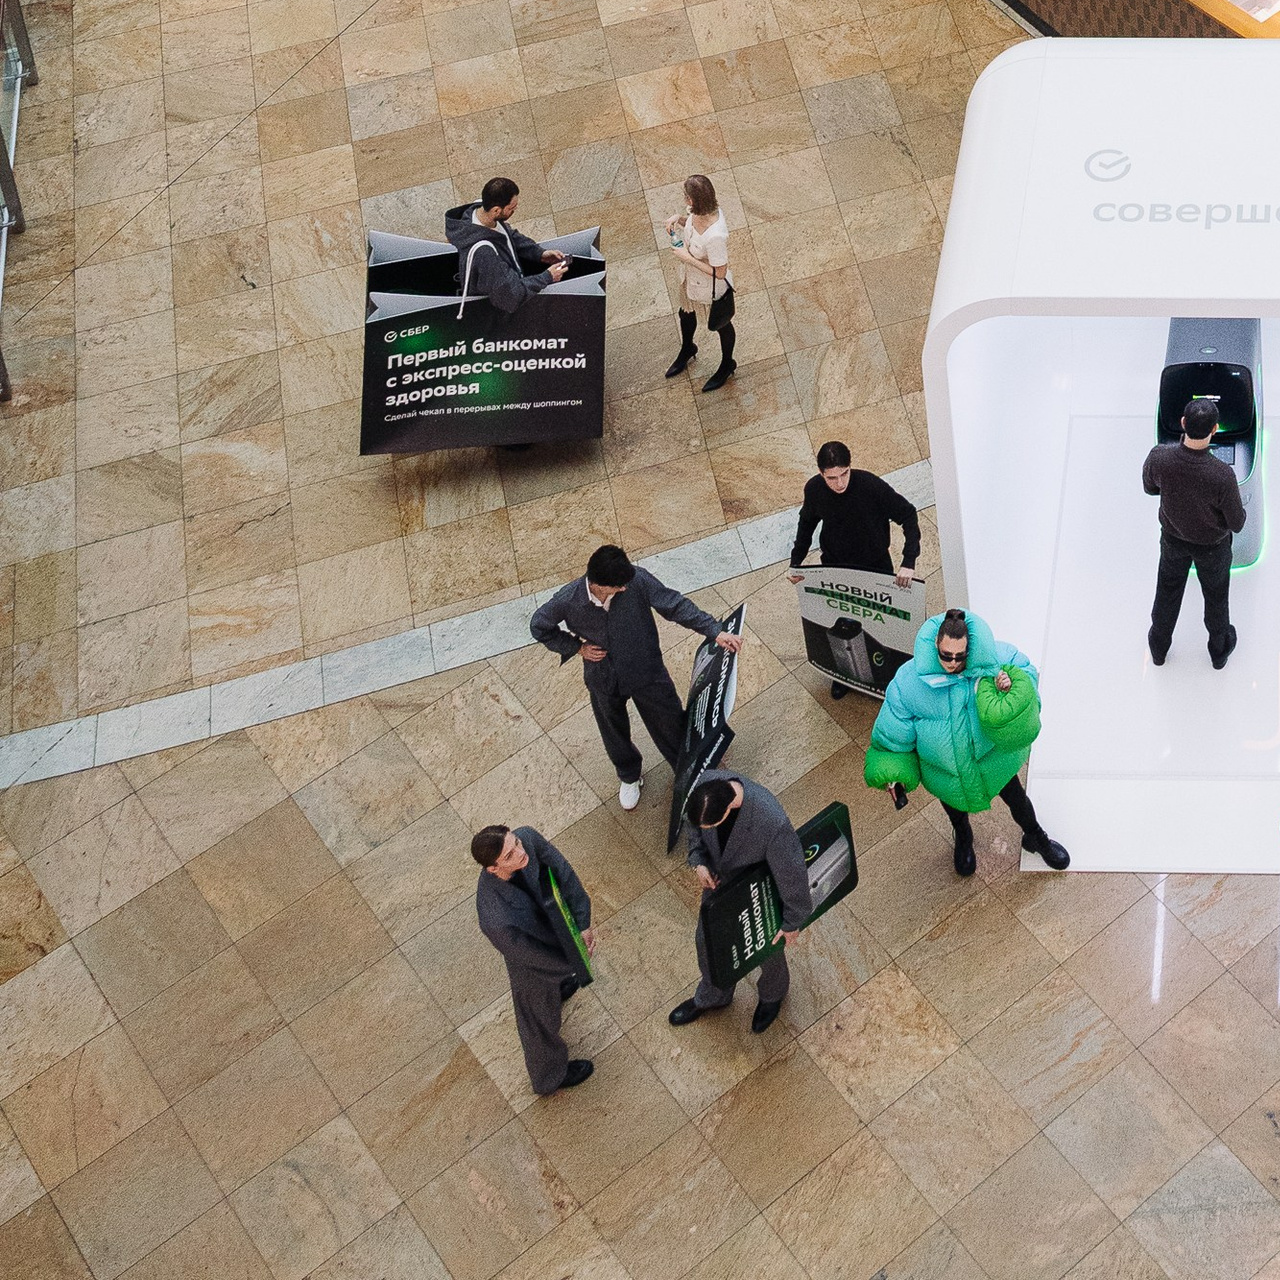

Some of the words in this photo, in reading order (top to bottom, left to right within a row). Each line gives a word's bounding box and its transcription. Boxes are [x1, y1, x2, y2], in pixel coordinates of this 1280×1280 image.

[400, 325, 430, 338] СБЕР
[387, 341, 467, 369] Первый
[472, 337, 569, 354] банкомат
[386, 375, 397, 388] с
[402, 353, 587, 385] экспресс-оценкой
[385, 383, 480, 407] здоровья
[384, 410, 417, 422] Сделай
[446, 407, 452, 415] в
[453, 403, 501, 415] перерывах
[503, 402, 532, 411] между
[821, 581, 892, 605] НОВЫЙ
[826, 599, 885, 624] СБЕРА
[750, 881, 766, 951] банкомат
[738, 908, 755, 961] Новый
